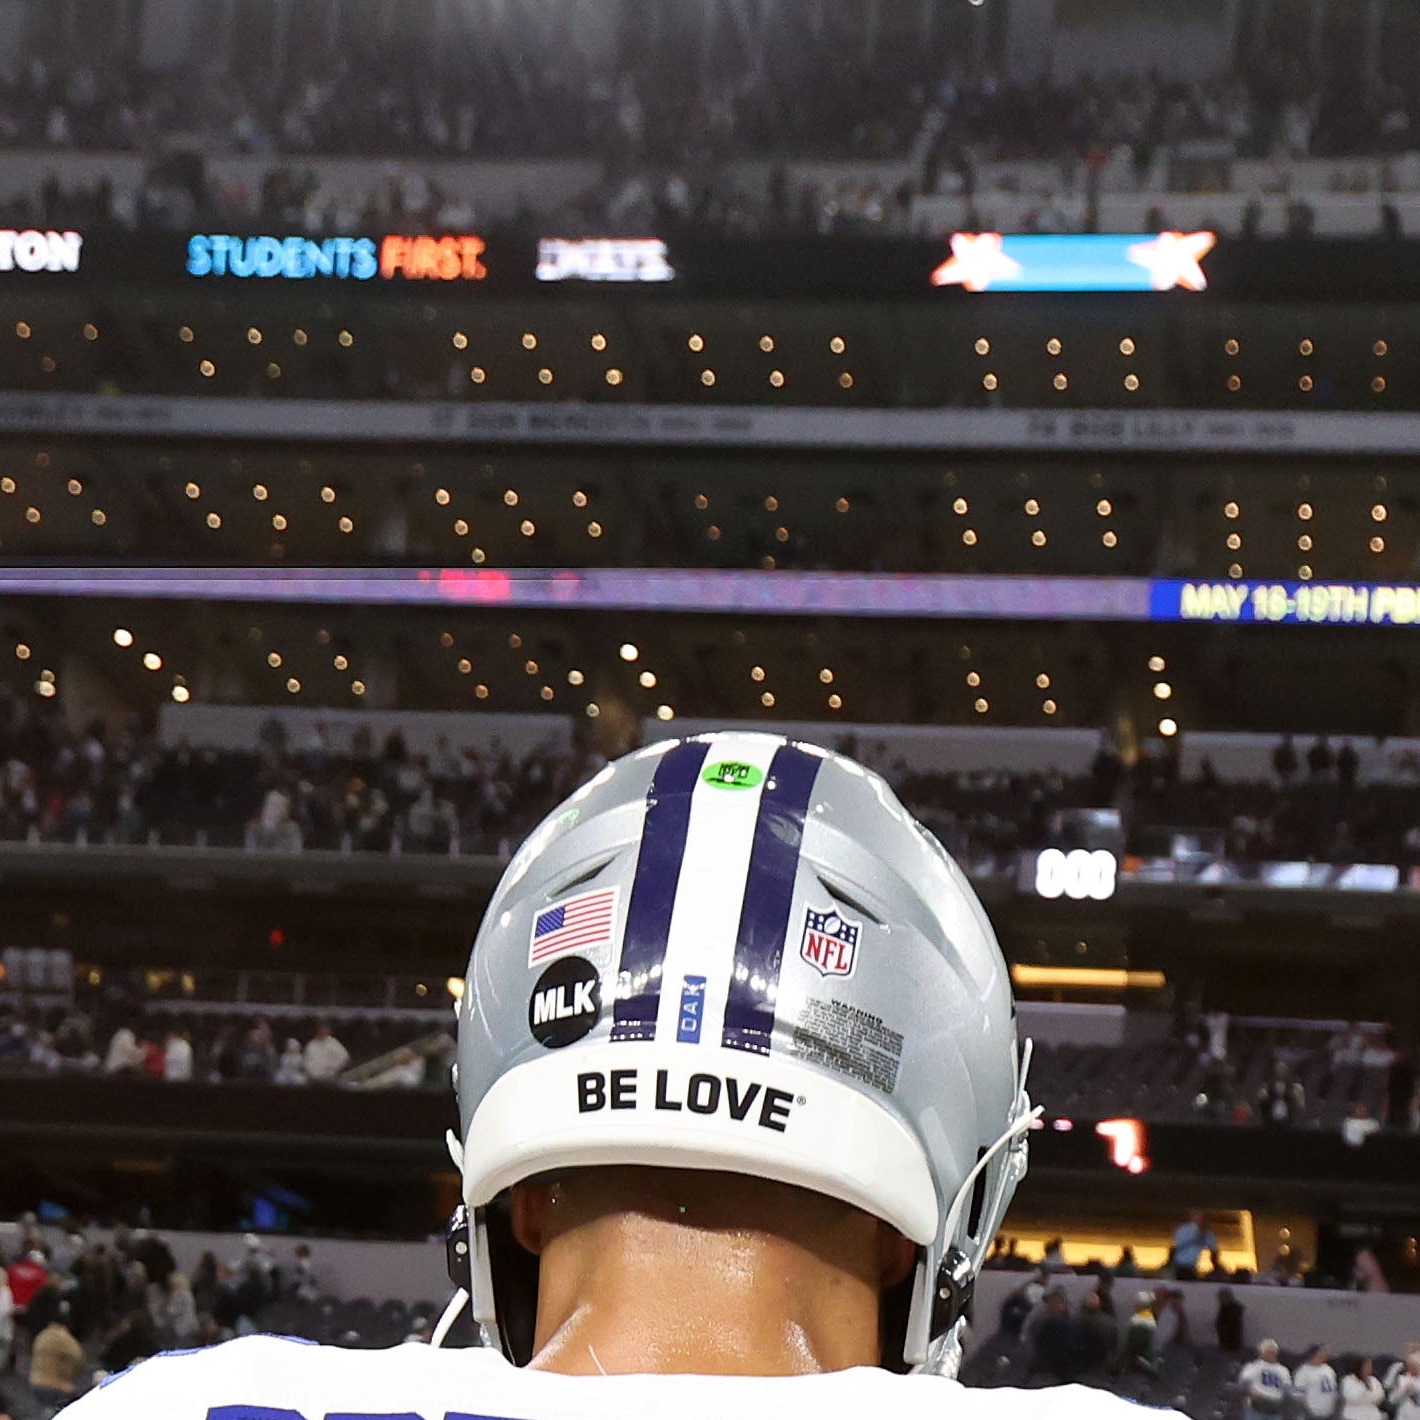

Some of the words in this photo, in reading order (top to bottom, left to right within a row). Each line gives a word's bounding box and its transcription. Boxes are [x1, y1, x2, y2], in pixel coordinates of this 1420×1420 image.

[185, 234, 377, 279] STUDENTS
[1181, 583, 1249, 620] MAY
[805, 931, 848, 970] NFL
[533, 979, 597, 1025] MLK
[681, 983, 701, 1032] DAK
[577, 1069, 637, 1113] BE
